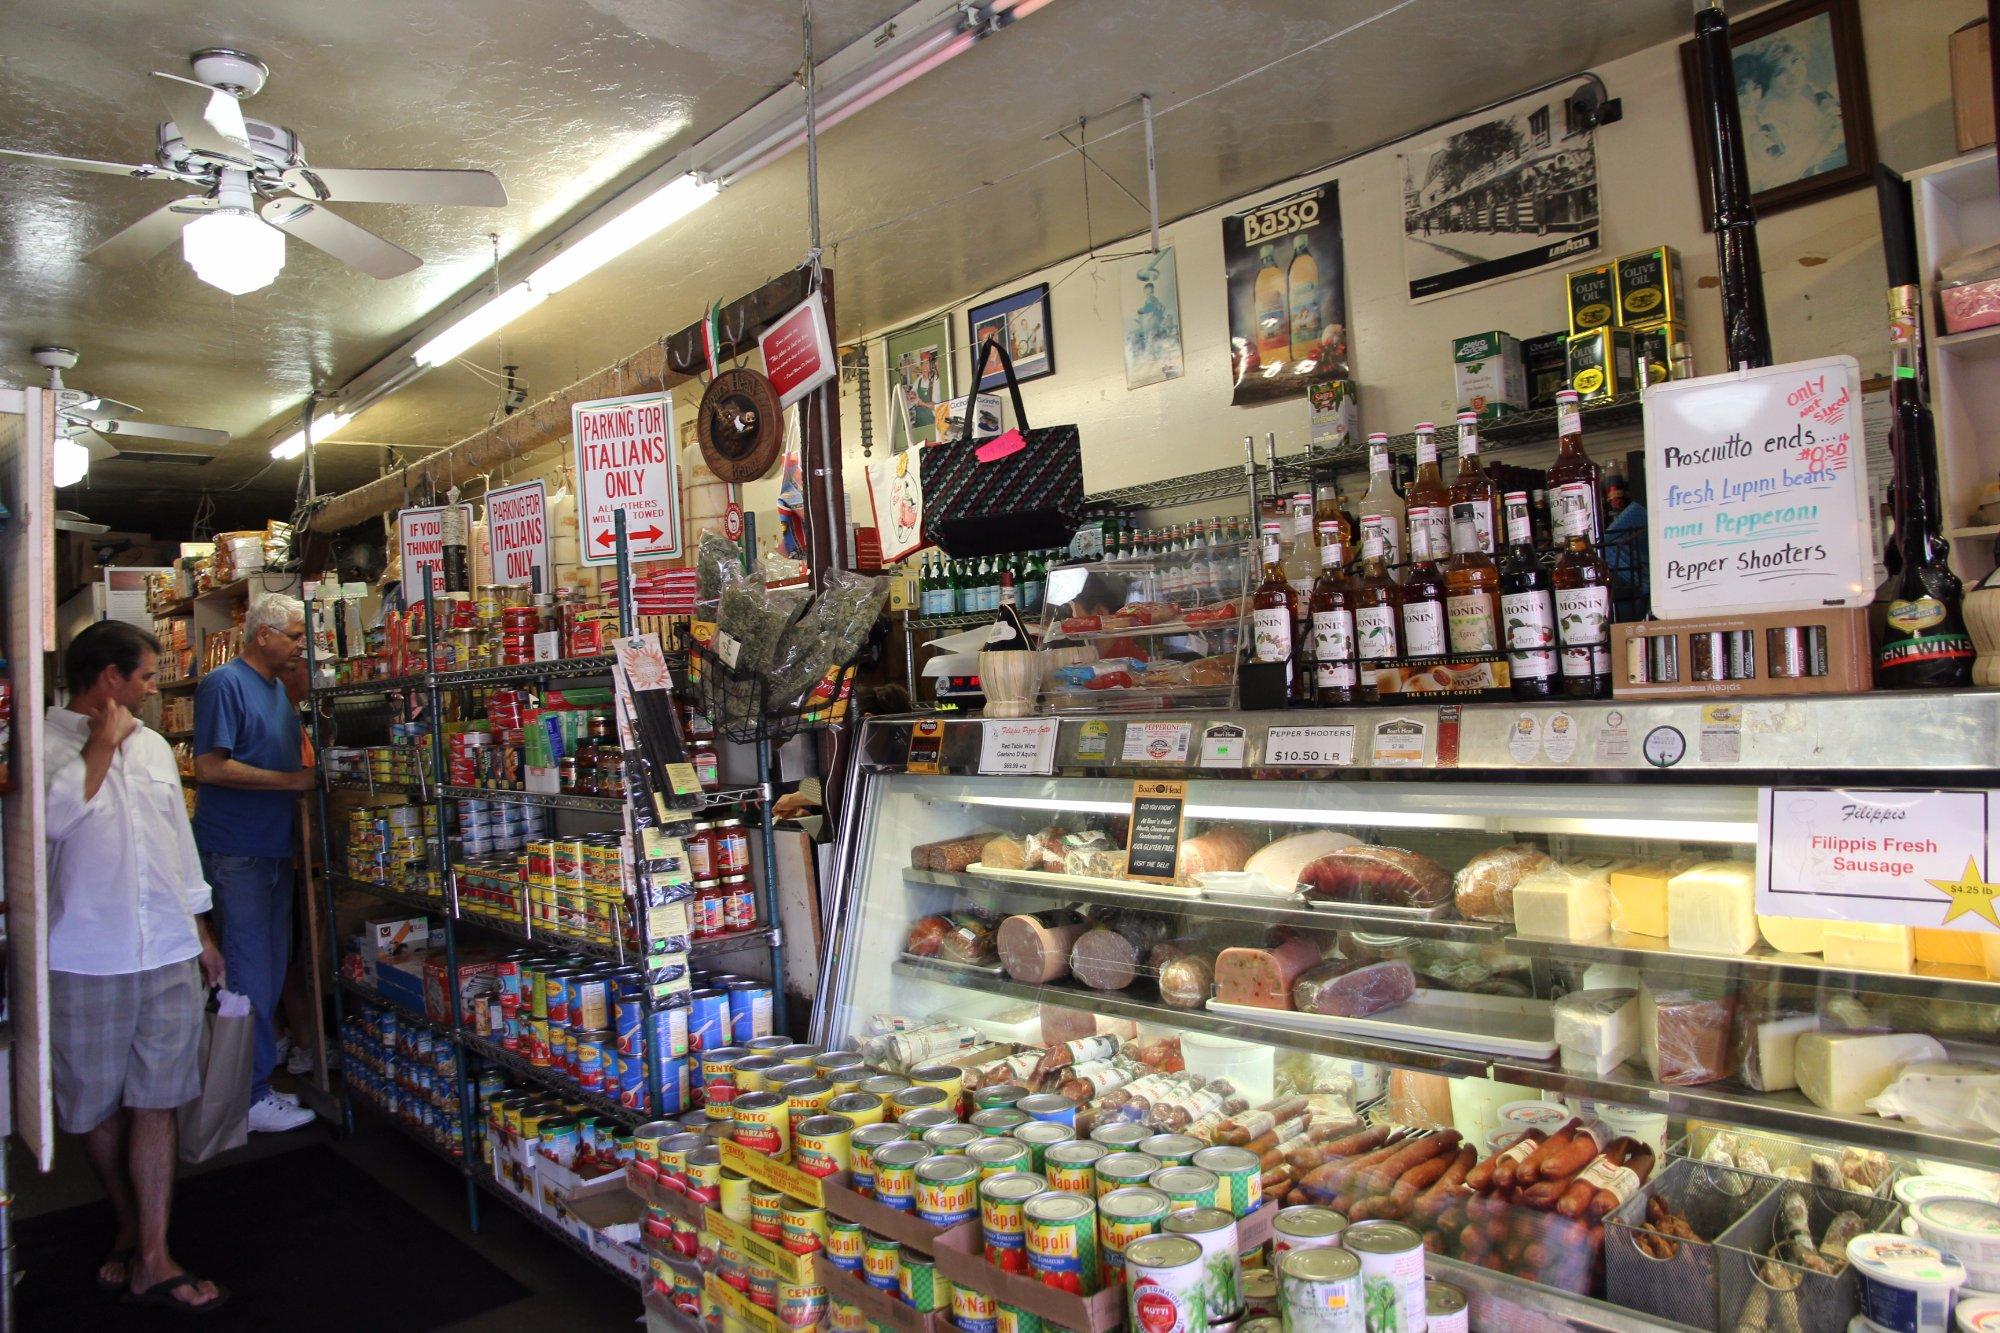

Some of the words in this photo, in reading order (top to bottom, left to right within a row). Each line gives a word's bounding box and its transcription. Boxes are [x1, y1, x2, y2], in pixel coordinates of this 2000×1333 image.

[1243, 199, 1319, 242] Basso
[1548, 237, 1591, 258] LAVAZZA
[1624, 262, 1656, 278] OLIVE
[1575, 280, 1606, 294] OLIVE
[1630, 275, 1651, 287] OIL
[1582, 291, 1601, 302] OIL
[584, 410, 634, 442] PARKING
[638, 406, 662, 435] FOR
[584, 436, 665, 472] ITALIANS
[1664, 432, 1753, 469] Prosciutto
[605, 468, 646, 499] ONLY
[1665, 479, 1714, 508] fresh
[1723, 477, 1776, 503] Lupini
[1783, 467, 1836, 489] beans
[493, 496, 525, 523] PARKING
[526, 493, 541, 515] FOR
[598, 503, 615, 514] ALL
[620, 499, 658, 512] OTHERS
[592, 514, 613, 524] WILL
[633, 508, 664, 520] TOWED
[1664, 522, 1703, 540] mini
[1716, 505, 1820, 536] Pepperoni
[410, 523, 419, 537] IF
[420, 521, 441, 537] YOU
[494, 517, 543, 552] ITALIANS
[407, 539, 445, 556] THINKIN
[506, 549, 533, 580] ONLY
[1668, 556, 1729, 581] Pepper
[1736, 542, 1827, 572] Shooters
[1504, 602, 1544, 615] MONIN
[1560, 599, 1603, 611] MONIN
[1256, 619, 1282, 628] ONIN
[1357, 618, 1386, 628] ONIN
[1404, 613, 1434, 623] ONIN
[1315, 621, 1347, 631] ONIN
[1452, 671, 1488, 687] MONIN
[1705, 683, 1742, 693] spicely
[1144, 722, 1180, 732] PEPPERONI
[1270, 730, 1302, 738] PEPPER
[1304, 729, 1351, 738] SHOOTERS
[1274, 751, 1320, 762] $10.50
[1324, 752, 1340, 761] LB
[1138, 784, 1156, 793] Boar's
[1164, 785, 1182, 794] Head
[1841, 804, 1908, 824] Filippis
[1143, 843, 1162, 852] GLUTEN
[1811, 835, 1877, 854] Filippis
[1883, 837, 1938, 854] Fresh
[1833, 856, 1914, 877] Sausage
[1950, 884, 1980, 895] $4.25
[1982, 884, 1993, 895] lb
[705, 1064, 734, 1073] CENTO
[710, 1106, 732, 1114] PURE
[635, 1141, 650, 1151] NTO
[797, 1138, 822, 1150] NTO
[660, 1154, 678, 1164] NTO
[800, 1156, 831, 1169] ARZANO
[686, 1168, 703, 1178] NTO
[875, 1171, 911, 1190] Napoli
[1050, 1172, 1090, 1191] Napoli
[752, 1198, 779, 1209] ENTO
[753, 1214, 780, 1225] MARZAN
[781, 1212, 806, 1226] NTO
[984, 1207, 1023, 1228] Napol
[783, 1230, 815, 1246] ARZANO
[827, 1236, 860, 1253] apoli
[1027, 1230, 1070, 1252] Napoli
[864, 1255, 894, 1270] apoli
[787, 1286, 826, 1298] CENTO
[954, 1296, 996, 1316] DiNap
[1143, 1305, 1169, 1316] MUTTI
